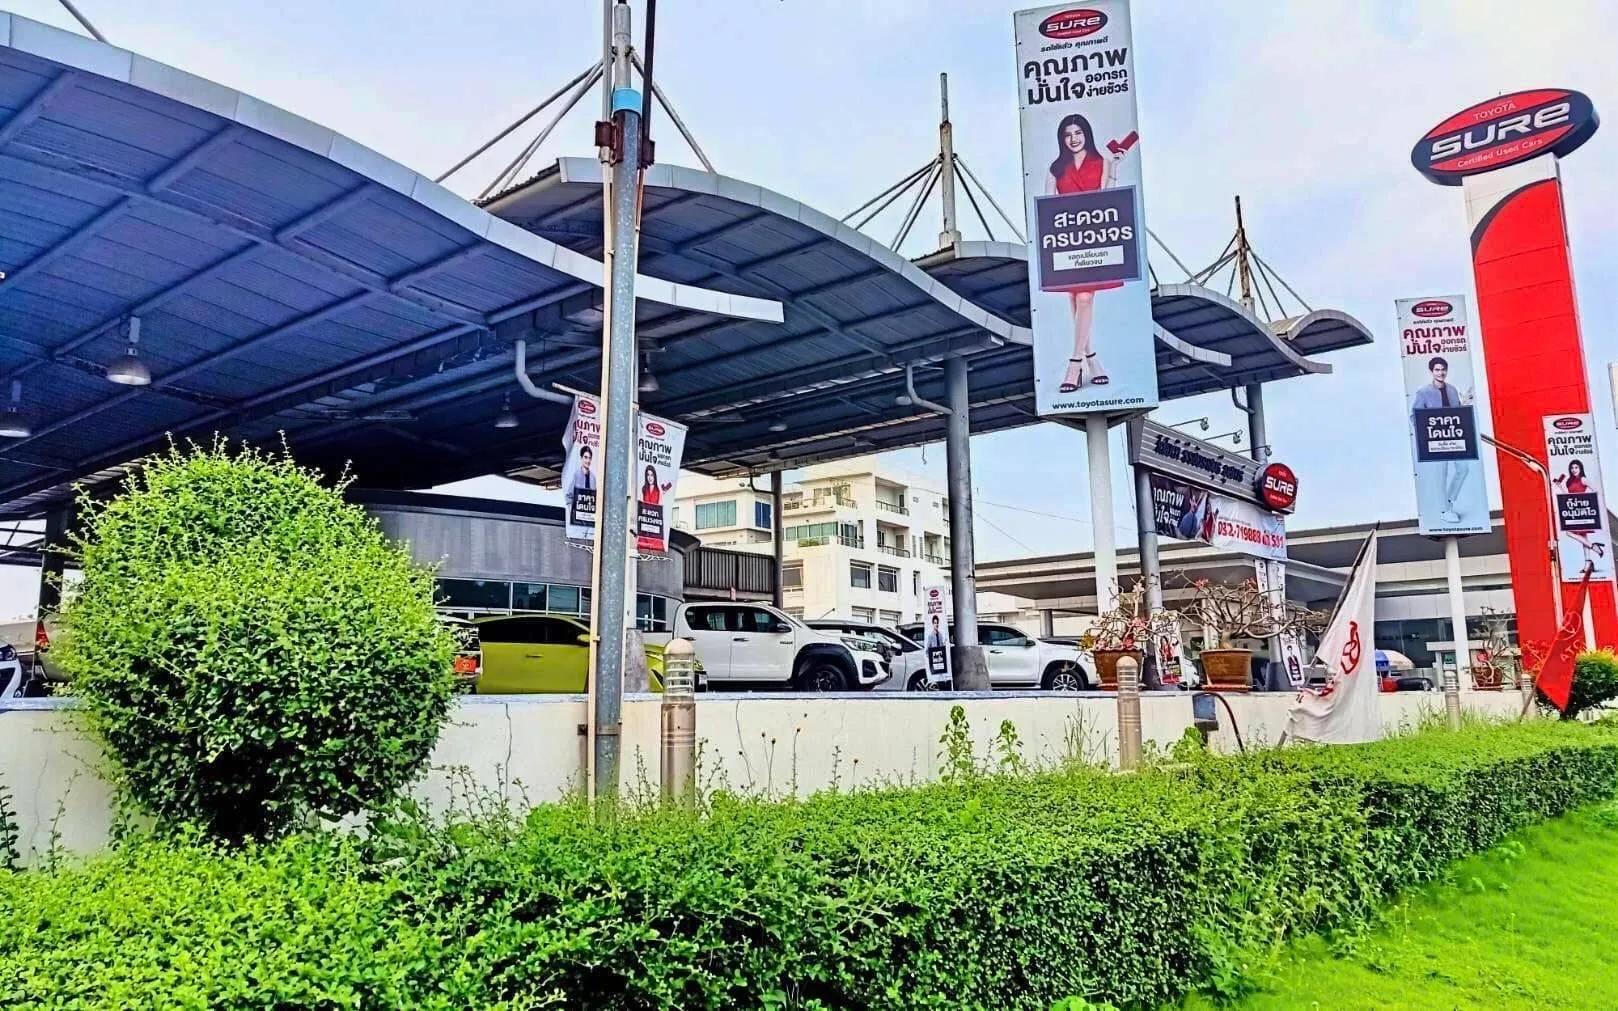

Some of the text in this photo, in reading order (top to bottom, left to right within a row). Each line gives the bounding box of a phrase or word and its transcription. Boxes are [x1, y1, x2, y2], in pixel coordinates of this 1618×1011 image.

[1046, 16, 1100, 32] SURE
[1024, 48, 1127, 82] คุณภาพ
[1085, 69, 1128, 83] ออกรถ
[1028, 78, 1086, 105] มั่นใจ
[1086, 80, 1129, 97] ง่ายชัวร์
[1473, 102, 1517, 120] TOYOTA
[1430, 102, 1570, 160] SURE
[1457, 138, 1543, 168] Certified Used Cars
[1054, 207, 1118, 228] สะดวก
[1043, 226, 1133, 249] ครบวงจร
[1403, 325, 1465, 341] คุณภาพ
[1406, 340, 1441, 354] มั่นใจ
[1052, 397, 1145, 409] www.toyotasure.com
[1428, 416, 1460, 425] ราคา
[1427, 426, 1464, 438] โดนใจ
[639, 438, 672, 453] คุณภาพ
[1548, 435, 1592, 447] คุณภาพ
[1264, 476, 1294, 497] SURE
